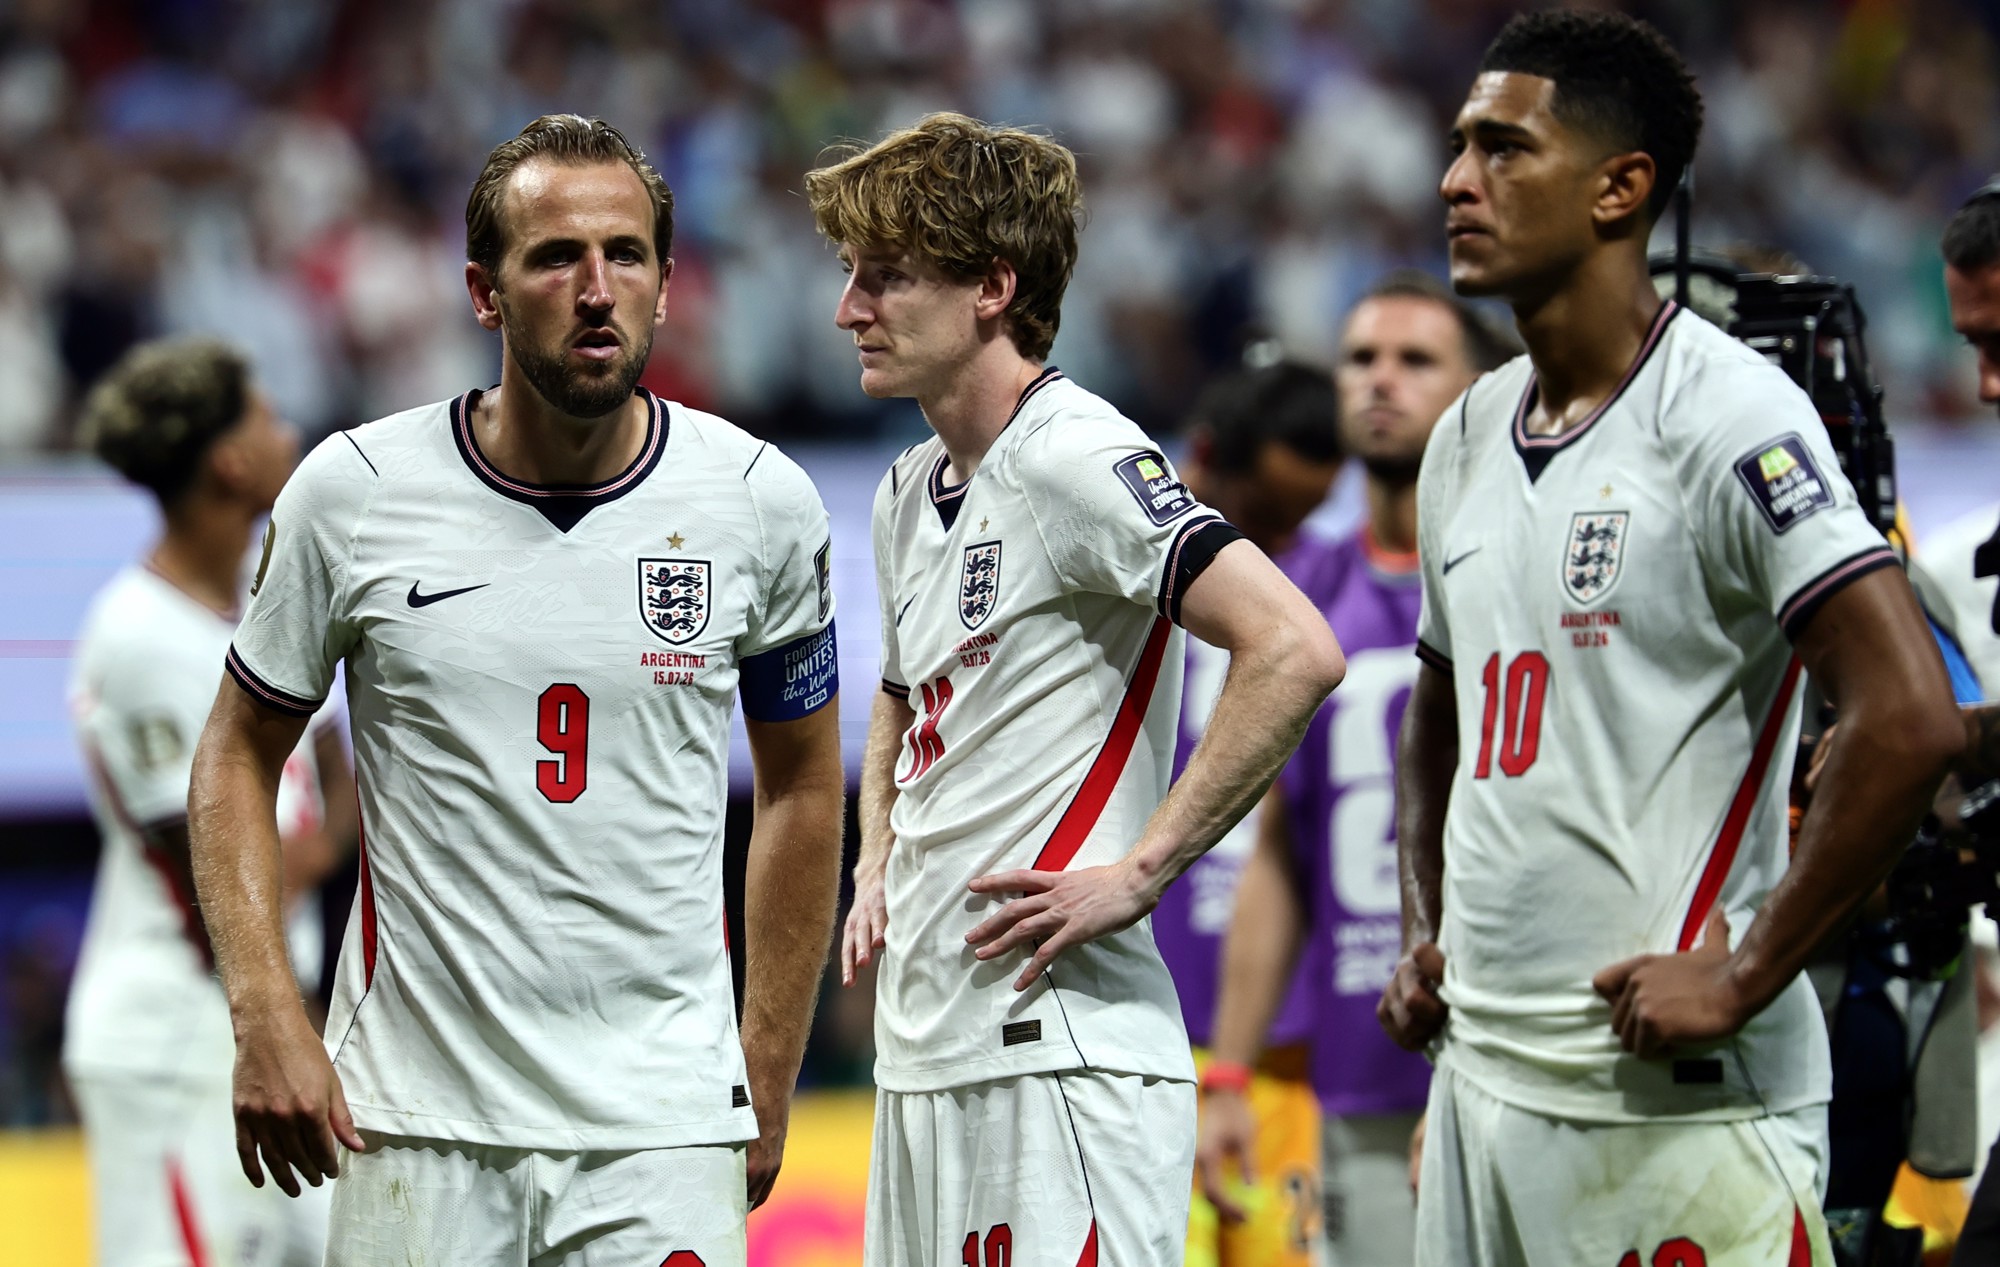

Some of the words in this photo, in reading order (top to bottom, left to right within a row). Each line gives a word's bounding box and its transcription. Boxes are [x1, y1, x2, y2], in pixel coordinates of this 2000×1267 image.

[1560, 610, 1621, 629] ARGENTINA
[784, 626, 832, 666] FOOTBALL
[951, 632, 999, 655] GENTINA
[640, 652, 706, 669] ARGENTINA
[786, 640, 834, 683] UNITES
[653, 671, 695, 687] 15.07.26
[780, 683, 808, 702] the
[808, 657, 836, 693] World
[804, 690, 827, 709] FIFA
[1473, 650, 1551, 780] 10
[536, 682, 590, 804] 9
